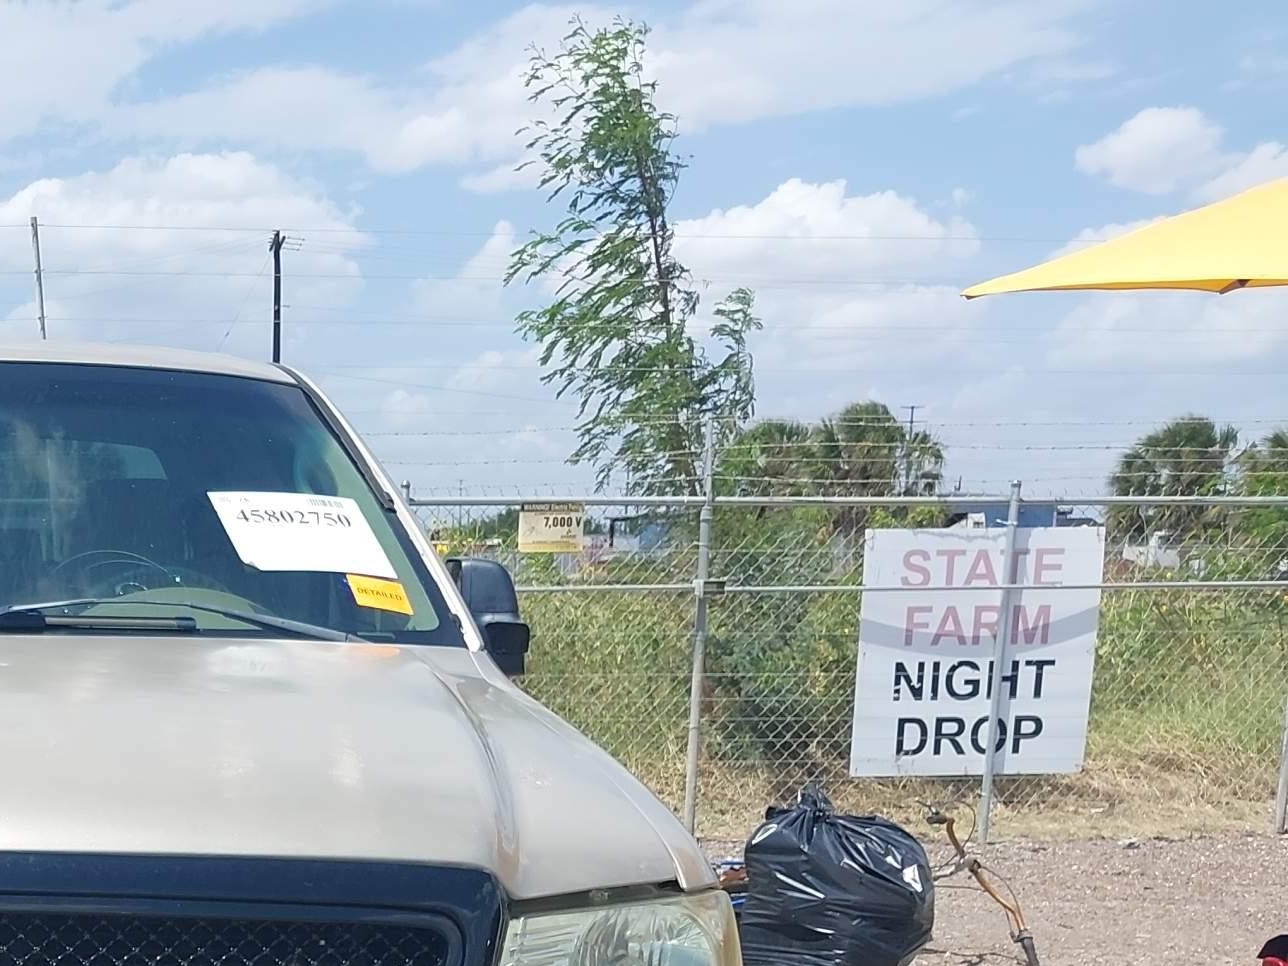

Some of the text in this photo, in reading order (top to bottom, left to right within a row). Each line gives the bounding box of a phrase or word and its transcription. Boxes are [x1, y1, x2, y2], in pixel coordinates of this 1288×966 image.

[237, 507, 352, 528] 45802750
[544, 516, 582, 528] 7,000 V
[900, 548, 1065, 588] STATE
[904, 605, 1051, 647] FARM
[893, 660, 1055, 701] NIGHT
[895, 715, 1044, 757] DROP
